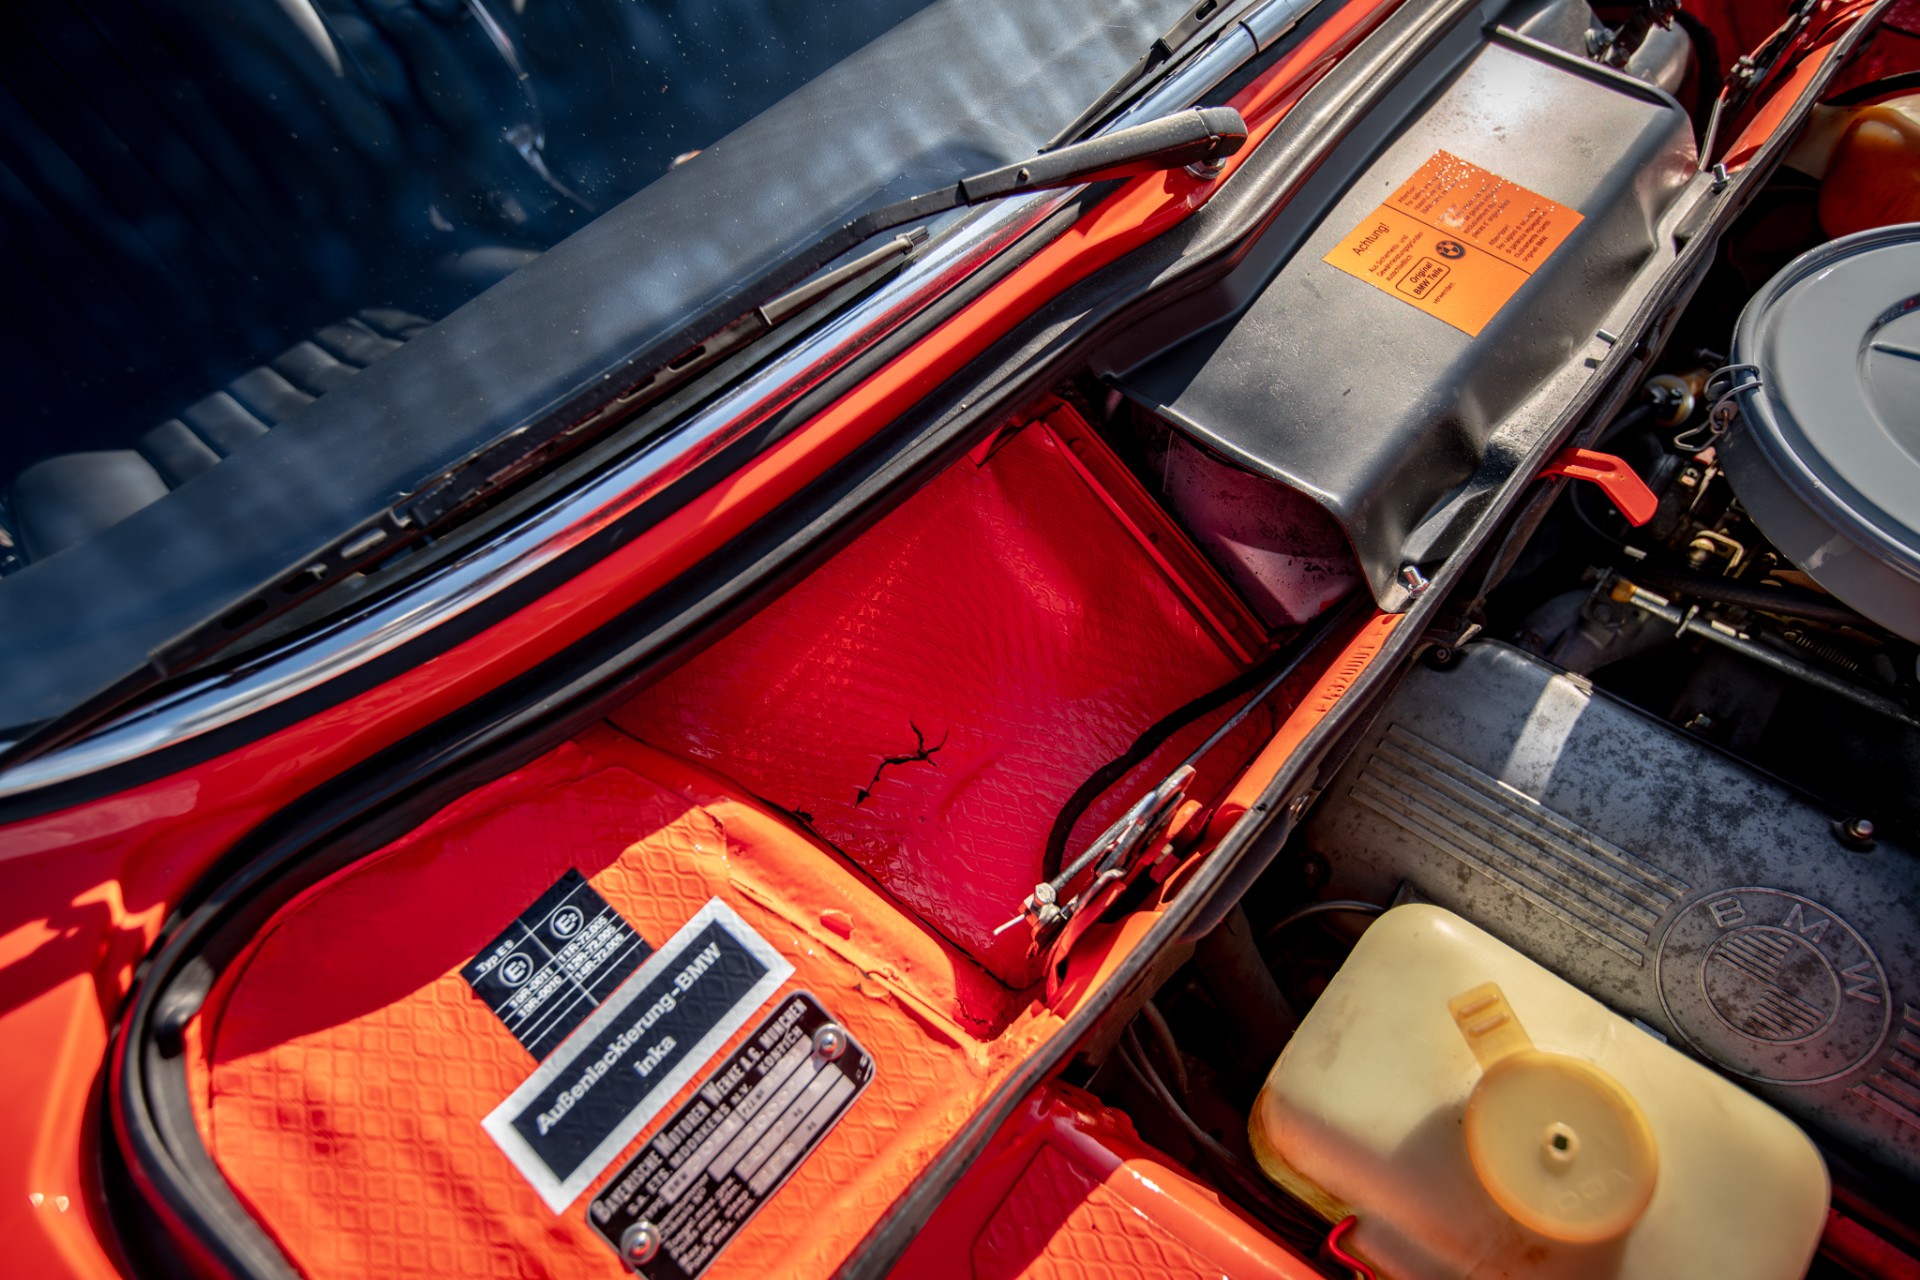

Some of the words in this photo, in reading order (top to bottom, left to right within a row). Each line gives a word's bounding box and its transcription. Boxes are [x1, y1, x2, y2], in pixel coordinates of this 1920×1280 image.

[1350, 221, 1392, 256] Achtung!
[1408, 261, 1435, 284] Original
[1412, 279, 1431, 295] BMW
[1426, 266, 1443, 281] Teile
[474, 951, 500, 976] Typ
[1708, 896, 1881, 1004] BMW
[530, 941, 727, 1137] Außenlackierung-BMW
[631, 1031, 678, 1078] inka
[644, 1163, 674, 1195] ETS.
[668, 1102, 732, 1169] MOORKENS
[755, 1023, 804, 1075] KONTICH
[590, 1146, 664, 1224] BAYERISCHE
[651, 1095, 711, 1158] MOTOREN
[700, 1059, 746, 1107] WERKE
[737, 1042, 765, 1071] A.G.
